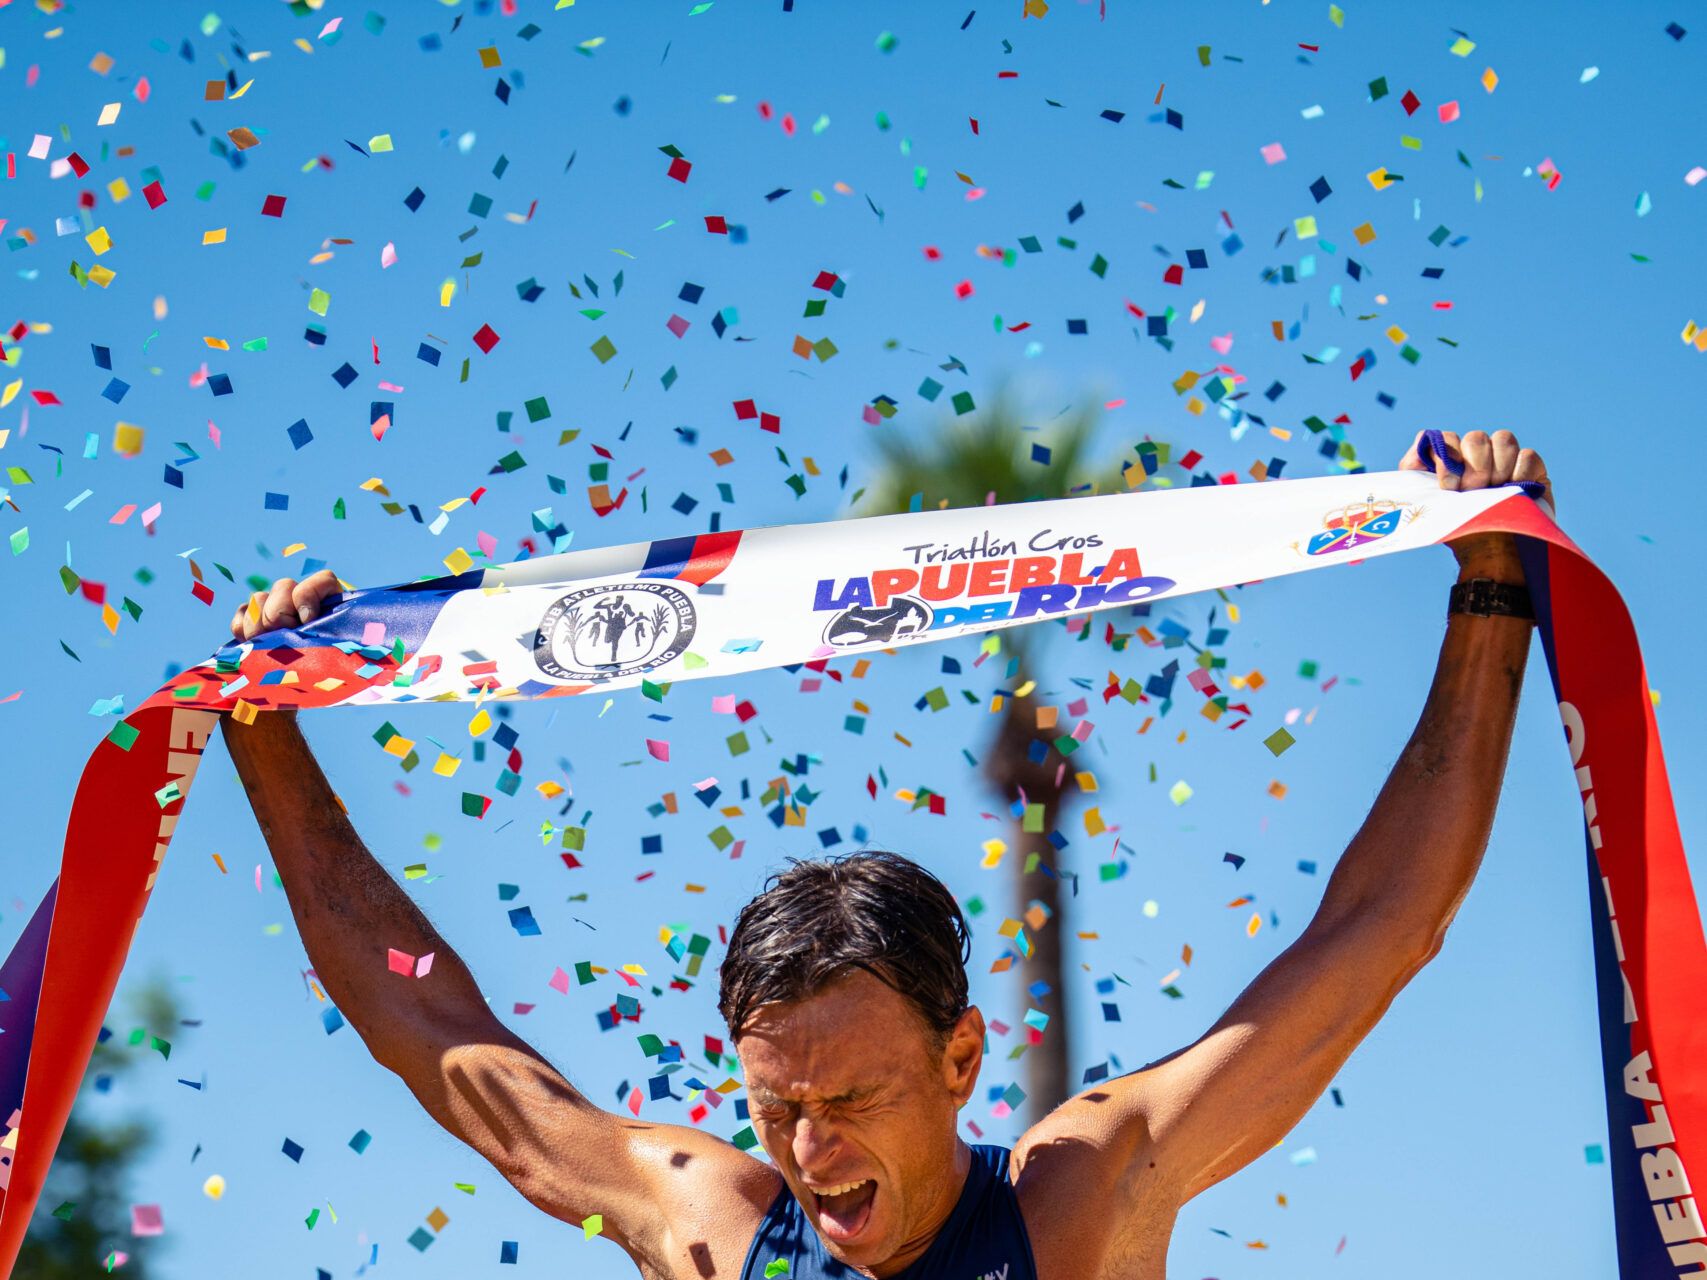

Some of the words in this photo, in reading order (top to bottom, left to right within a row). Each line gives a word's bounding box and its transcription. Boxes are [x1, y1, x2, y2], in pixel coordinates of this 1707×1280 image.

[903, 530, 1017, 564] Triatlón
[1028, 529, 1104, 552] Cros
[871, 547, 1143, 608] PUEBLA
[661, 587, 693, 633] PUEBLA
